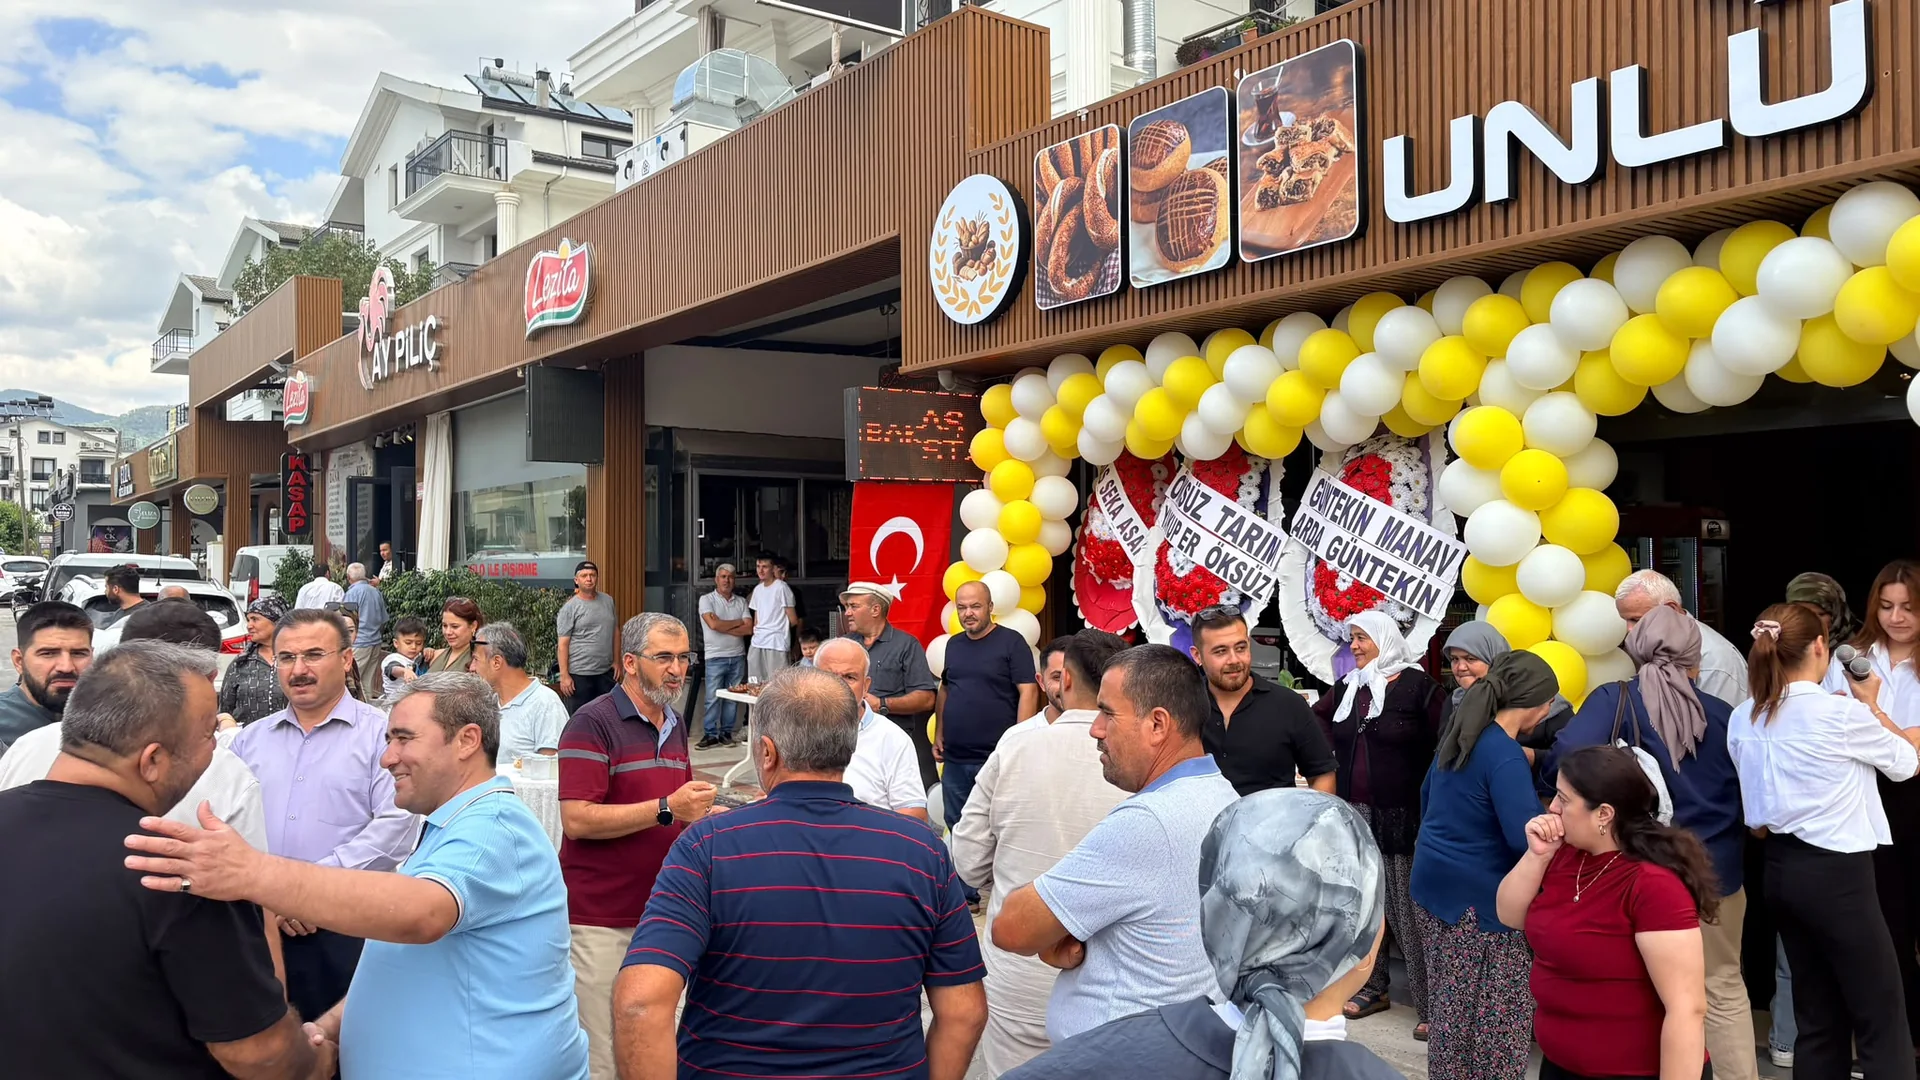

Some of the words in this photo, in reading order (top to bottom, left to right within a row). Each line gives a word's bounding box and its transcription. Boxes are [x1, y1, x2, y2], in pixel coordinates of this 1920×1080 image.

[532, 257, 581, 309] Lezita
[372, 336, 391, 383] AY
[285, 381, 306, 412] Lezita
[288, 455, 307, 533] KASAP
[1099, 479, 1125, 521] SEKA
[1177, 527, 1201, 558] ER
[1204, 541, 1272, 600] ÖKSÜZ
[1214, 504, 1281, 568] TARIM
[1291, 512, 1326, 552] ARDA
[1325, 536, 1442, 615] GÜNTEKİN
[1374, 515, 1460, 578] MANAV
